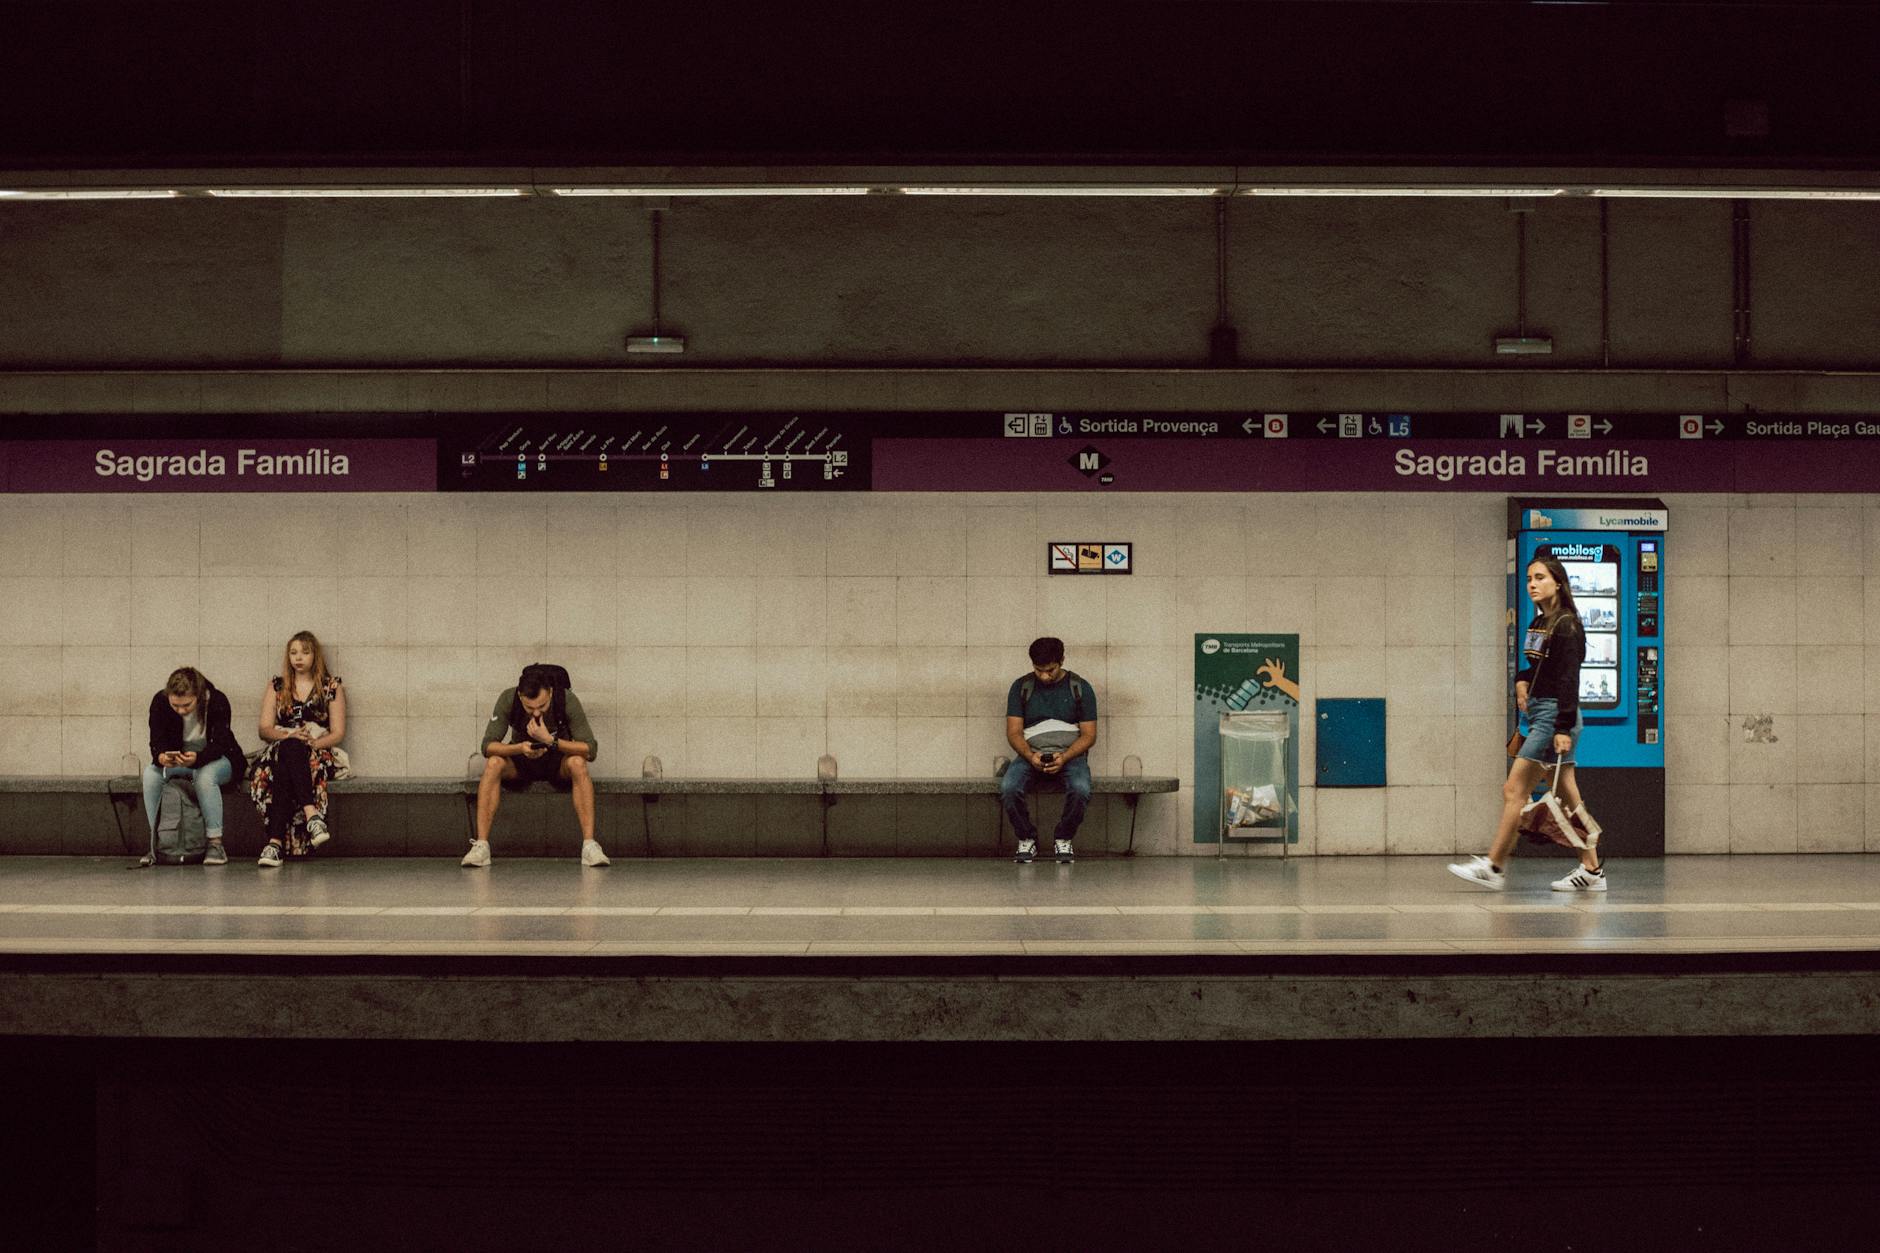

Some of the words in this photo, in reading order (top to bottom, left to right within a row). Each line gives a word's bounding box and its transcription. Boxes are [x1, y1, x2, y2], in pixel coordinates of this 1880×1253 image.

[1080, 418, 1137, 433] Sortida
[1143, 418, 1218, 438] Provença
[1389, 421, 1410, 437] L5
[1746, 421, 1802, 435] Sortida
[1807, 421, 1850, 439] Plaça
[95, 449, 226, 481] Sagrada
[237, 448, 349, 475] Família
[461, 454, 476, 465] L2
[834, 454, 847, 463] L2
[1080, 453, 1099, 470] M
[1395, 449, 1526, 481] Sagrada
[1537, 448, 1649, 476] Família
[1599, 516, 1659, 527] Lycamobile
